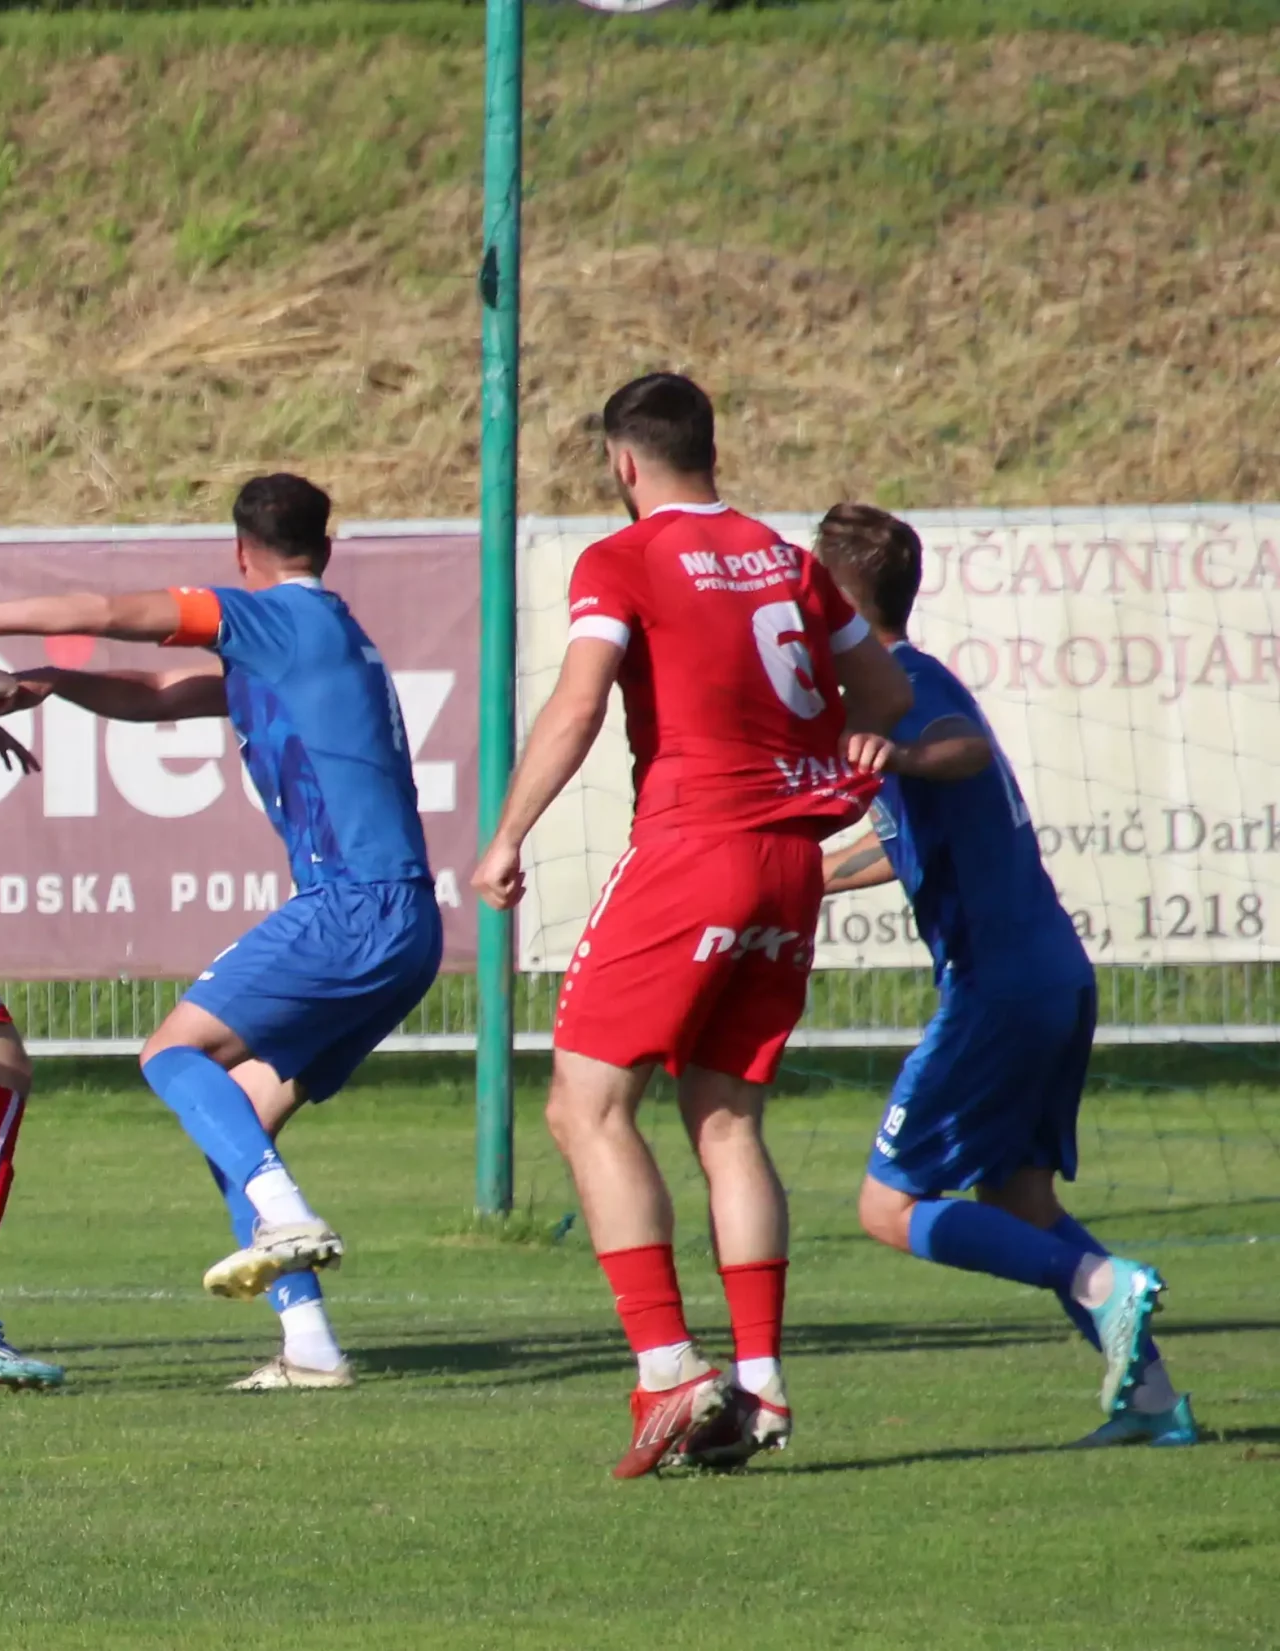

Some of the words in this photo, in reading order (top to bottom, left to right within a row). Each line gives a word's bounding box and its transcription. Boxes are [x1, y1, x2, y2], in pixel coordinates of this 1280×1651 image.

[679, 551, 725, 576] NK
[724, 545, 799, 578] POLET
[917, 523, 1280, 596] UČAVNIČA
[751, 600, 826, 720] 6
[1135, 893, 1265, 940] 1218
[883, 1104, 907, 1137] 19
